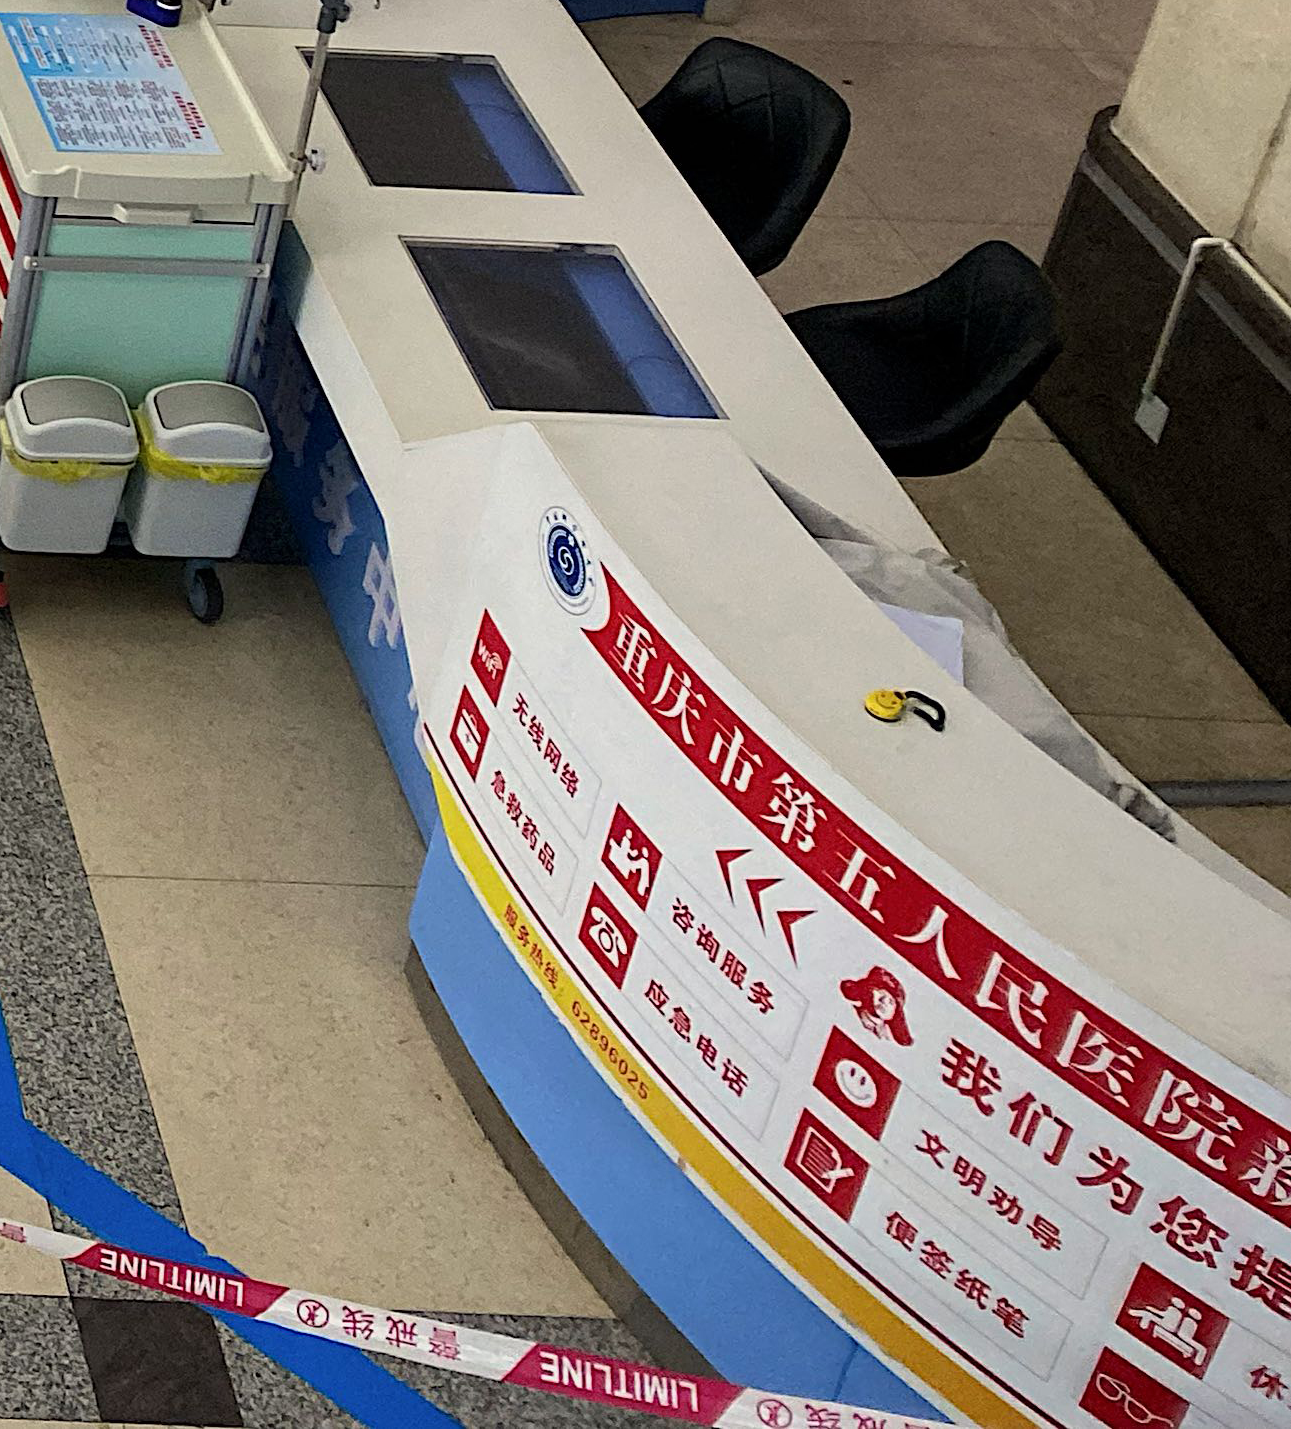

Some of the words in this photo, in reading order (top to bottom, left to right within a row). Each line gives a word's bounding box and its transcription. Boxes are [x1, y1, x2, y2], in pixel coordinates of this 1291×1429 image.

[512, 691, 580, 799] 无线网络
[490, 770, 557, 876] 急救药品
[671, 897, 775, 1015] 咨询服务
[570, 1000, 650, 1102] 62896025
[644, 979, 749, 1099] 应急电话
[914, 1128, 1063, 1253] 文明劝导
[939, 1036, 1291, 1322] 我们为您提
[98, 1247, 245, 1308] LIMITLINE
[340, 1305, 464, 1362] 警戒线
[539, 1351, 699, 1414] LIMITLINE
[884, 1210, 1031, 1339] 便签纸笔
